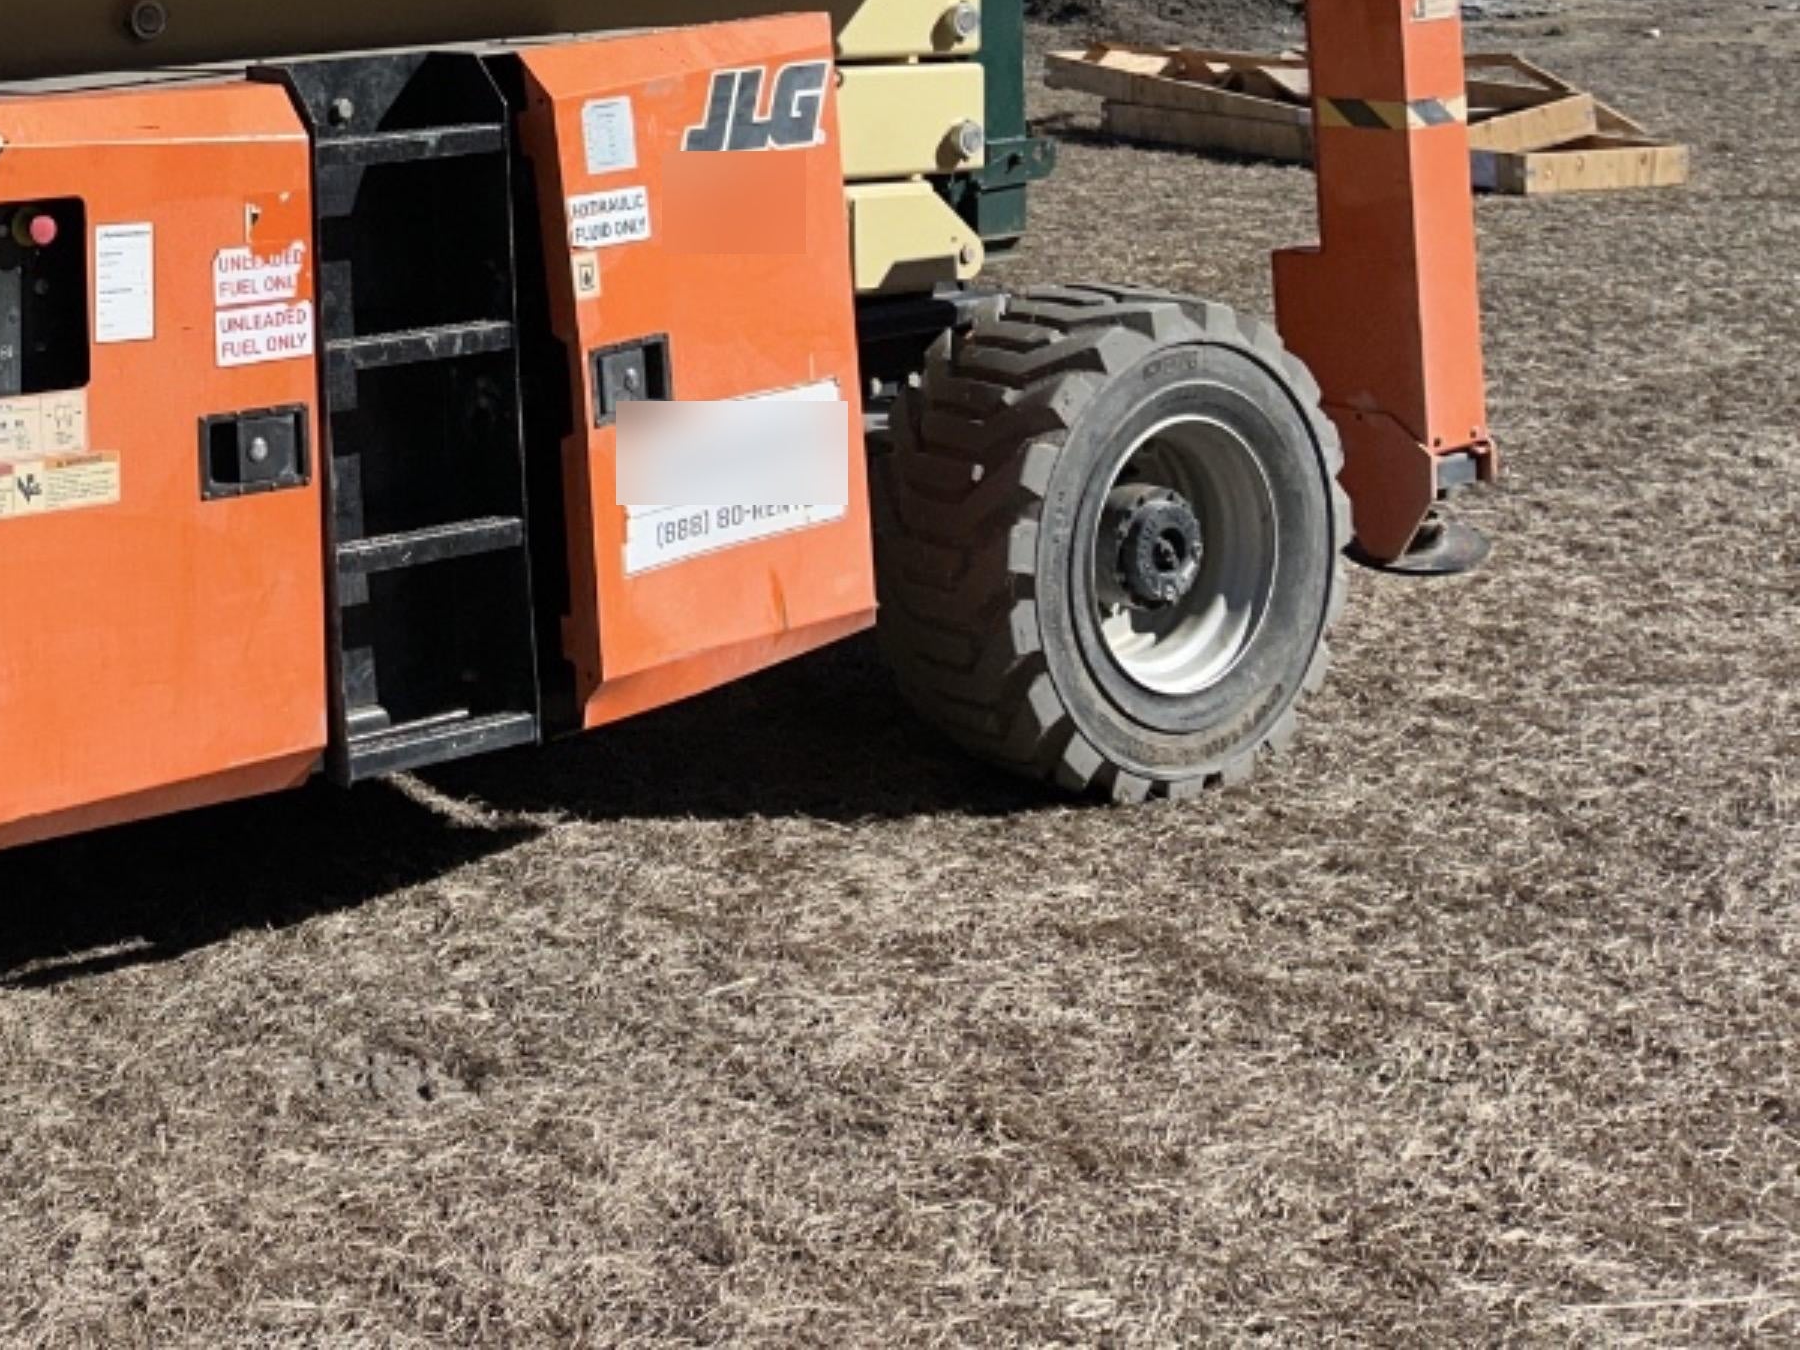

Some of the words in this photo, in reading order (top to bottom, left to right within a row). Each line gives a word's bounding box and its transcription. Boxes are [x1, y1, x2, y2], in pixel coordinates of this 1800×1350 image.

[680, 61, 832, 152] JLG
[572, 193, 644, 219] HYDRAULIC
[574, 220, 612, 243] FLUID
[614, 216, 646, 238] ONLY
[218, 248, 303, 274] UNLEDED
[219, 277, 260, 298] FUEL
[264, 273, 295, 293] ONL
[219, 308, 307, 334] UNLEADED
[221, 338, 262, 358] FUEL
[266, 331, 307, 353] ONLY
[656, 509, 709, 550] (888)
[716, 504, 814, 529] 80-RE
